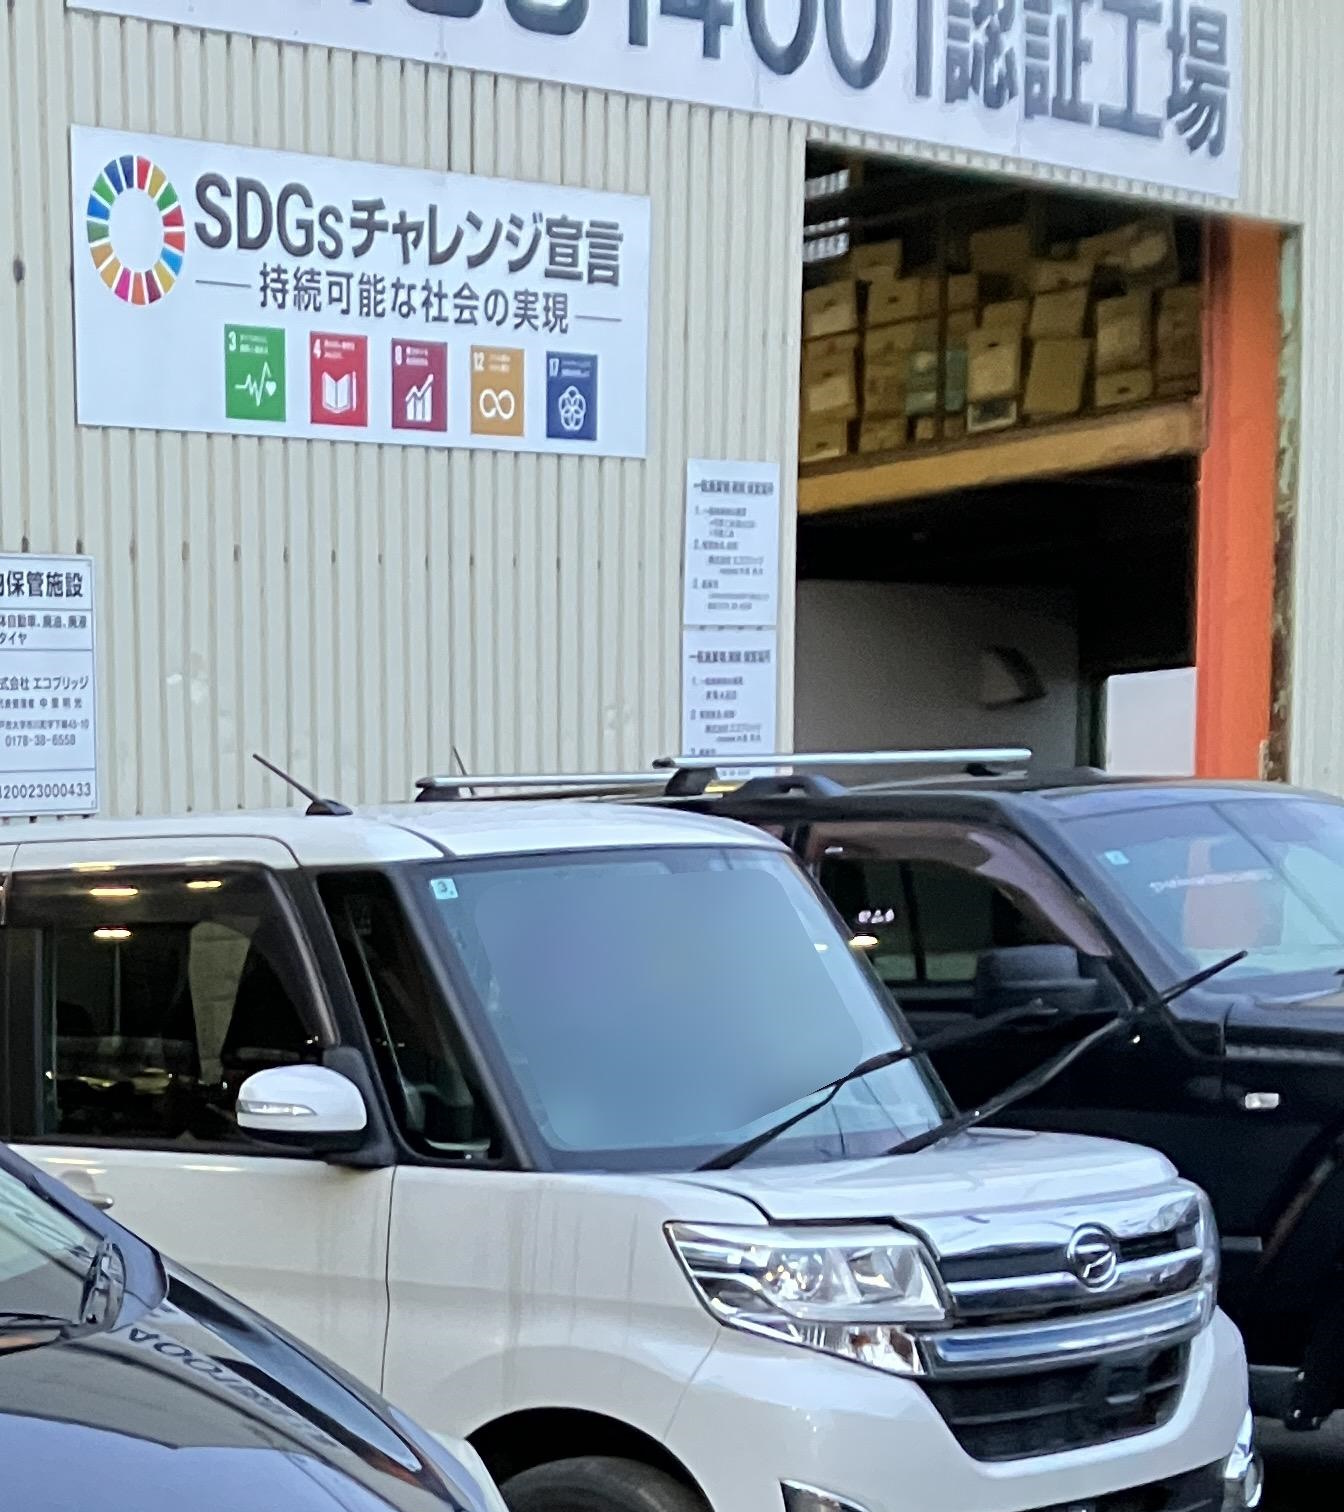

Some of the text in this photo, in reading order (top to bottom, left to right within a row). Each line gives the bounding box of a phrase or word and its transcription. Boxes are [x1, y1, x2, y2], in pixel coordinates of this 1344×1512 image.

[352, 0, 1230, 157] 001認証工場
[195, 172, 624, 286] SDGsチャレンジ宣言
[259, 262, 569, 335] 持続可能な社会の実現
[228, 331, 238, 353] 3
[313, 336, 322, 359] 4
[473, 351, 486, 372] 12
[33, 675, 89, 690] エコブリッジ
